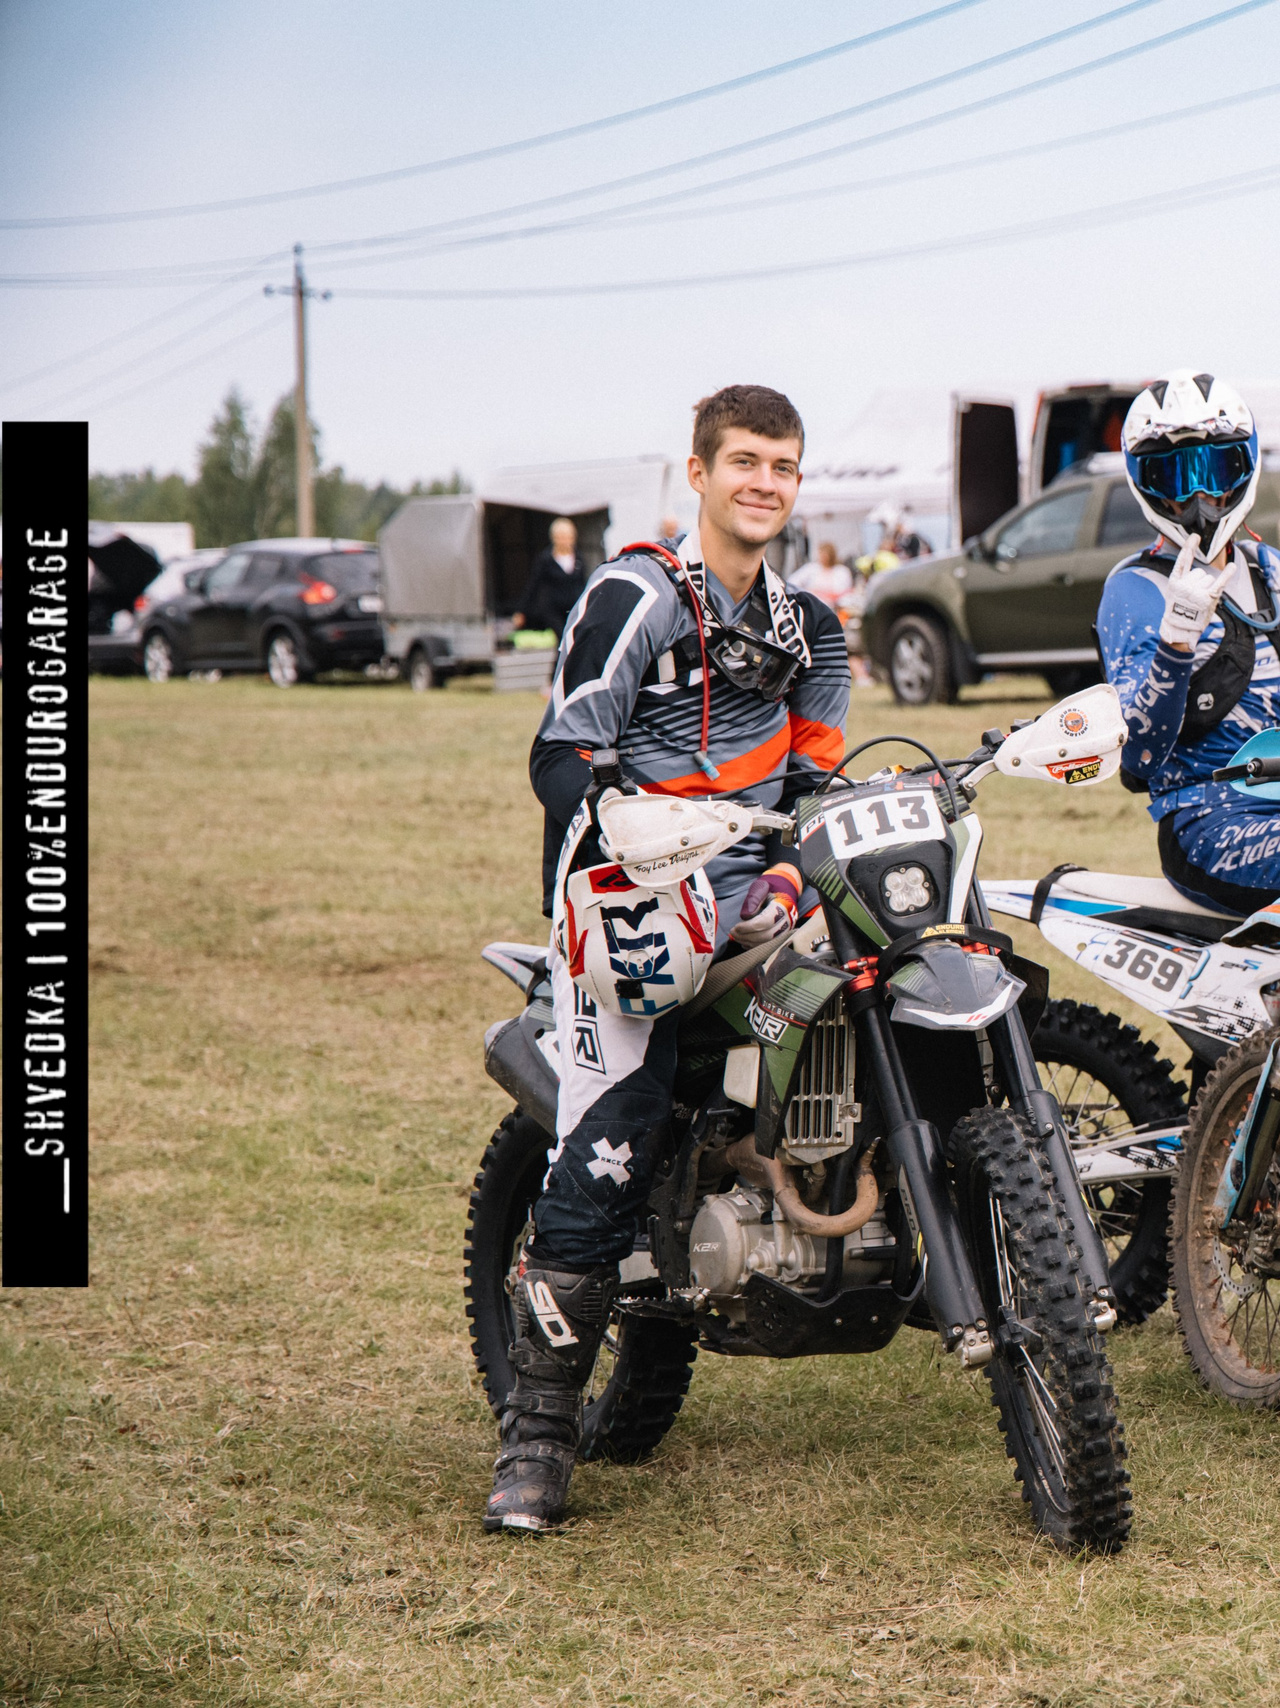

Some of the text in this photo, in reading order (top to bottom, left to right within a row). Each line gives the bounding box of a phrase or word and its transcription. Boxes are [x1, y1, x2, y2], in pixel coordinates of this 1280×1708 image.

[834, 795, 931, 847] 113
[633, 850, 700, 875] Troy Lee Designs
[1103, 938, 1184, 993] 369
[776, 1008, 796, 1020] BIKE
[692, 1242, 720, 1253] K2R
